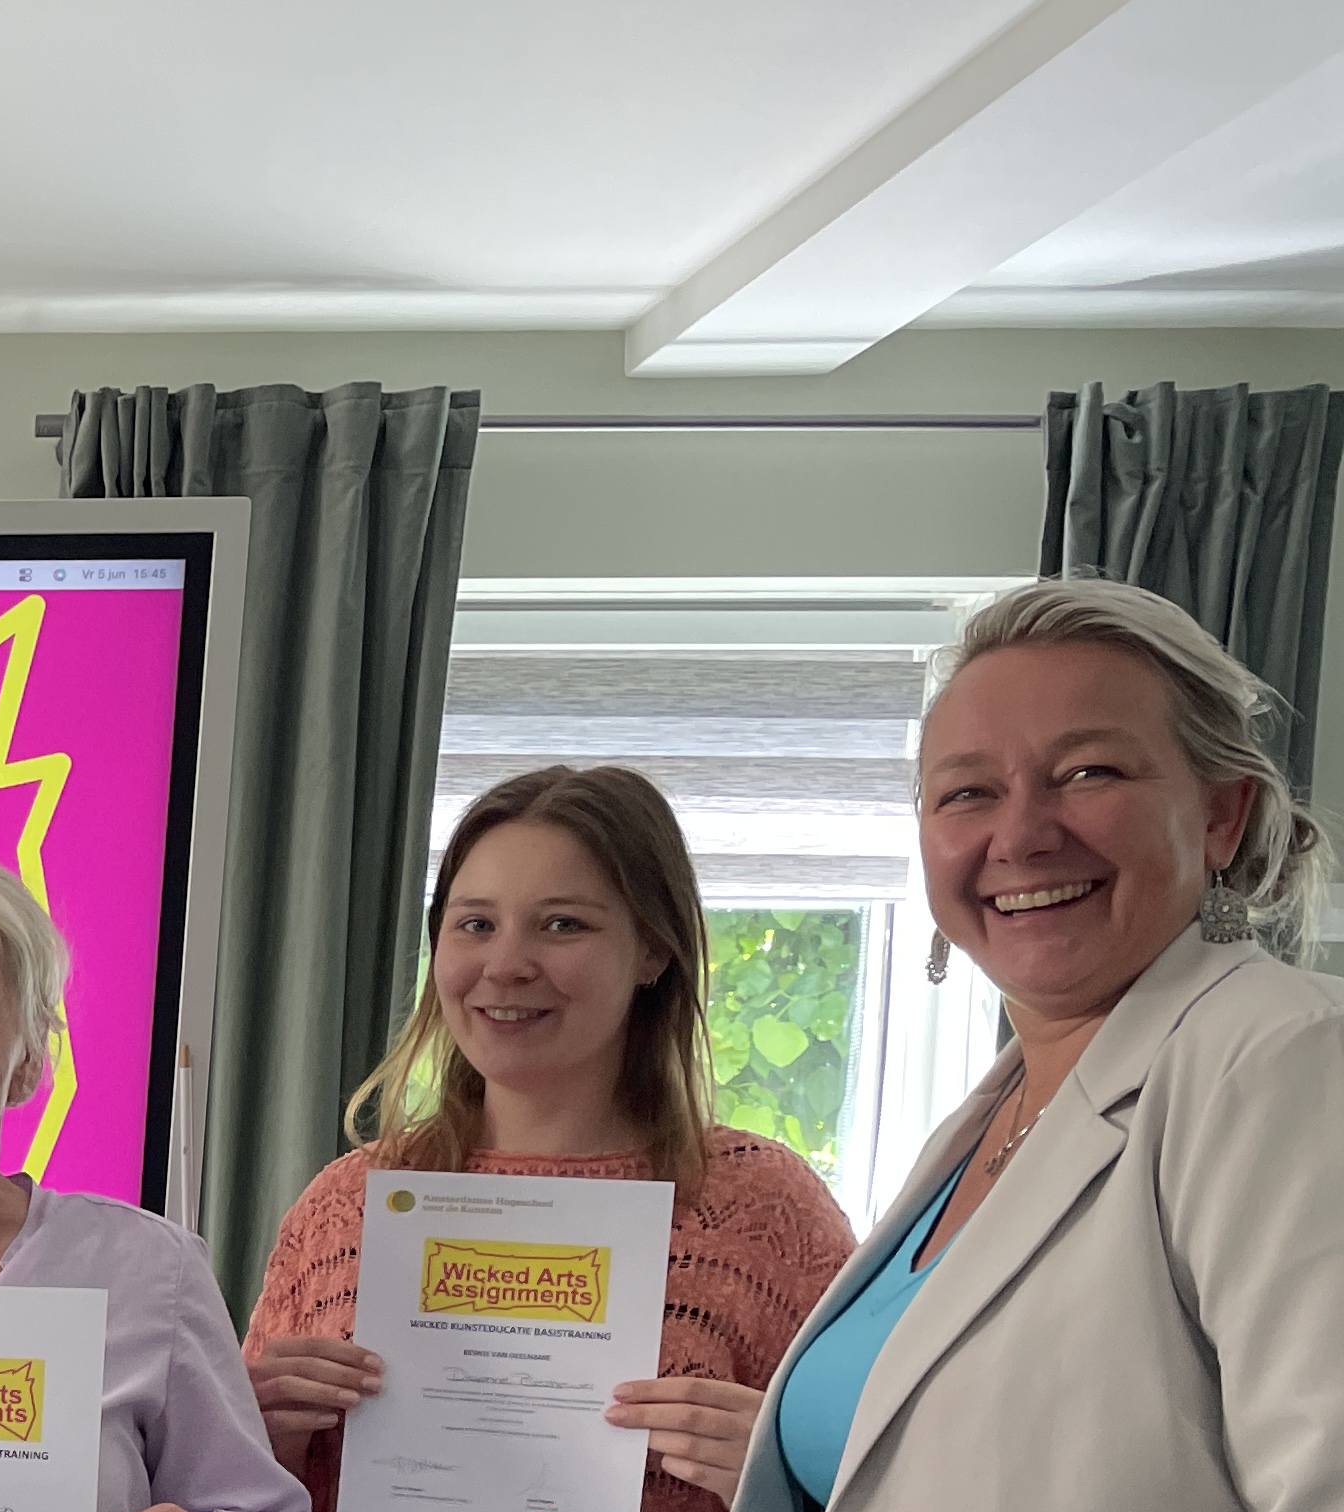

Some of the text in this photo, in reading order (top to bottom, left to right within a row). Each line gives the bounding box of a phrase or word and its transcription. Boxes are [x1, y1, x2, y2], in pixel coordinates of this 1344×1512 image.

[107, 569, 126, 582] jun
[443, 1262, 587, 1288] Wicked Arts
[433, 1279, 592, 1306] Assignments
